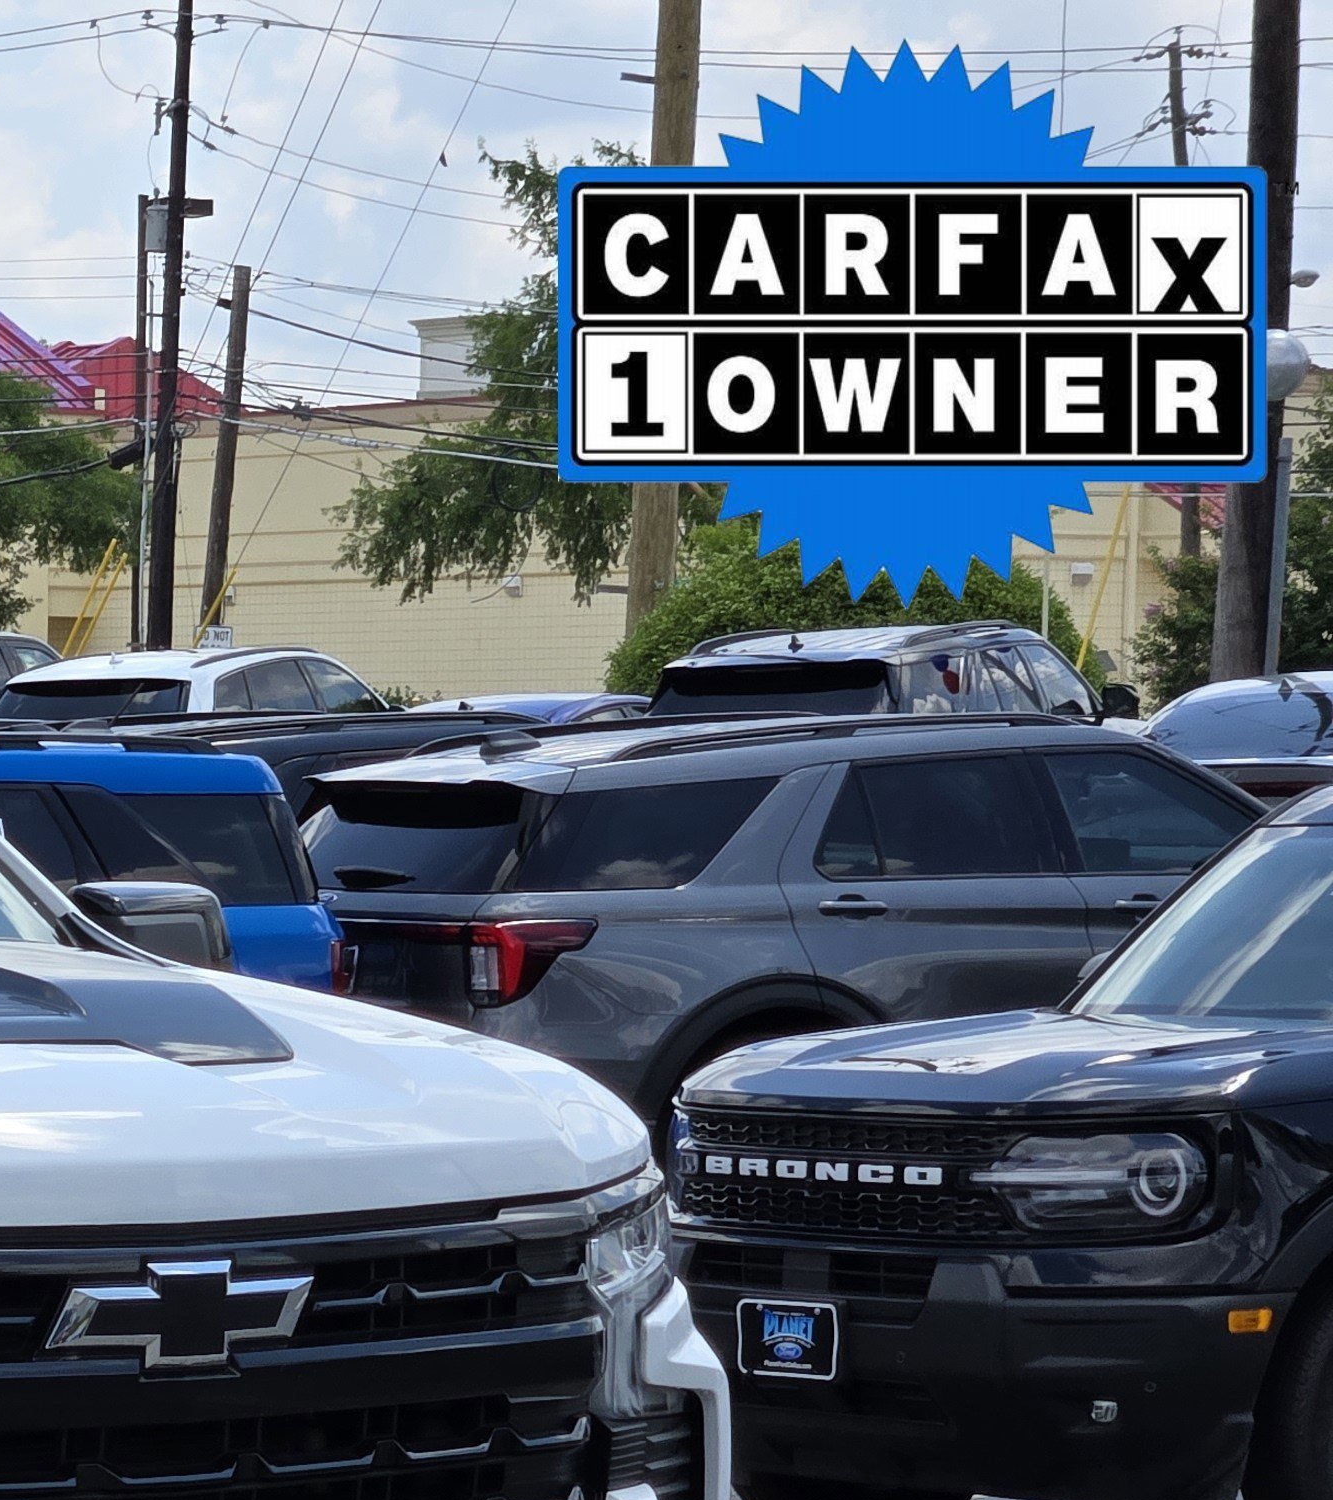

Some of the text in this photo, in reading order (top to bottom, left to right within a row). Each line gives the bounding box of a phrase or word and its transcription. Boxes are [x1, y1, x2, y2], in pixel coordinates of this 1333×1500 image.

[213, 630, 230, 641] NOT
[705, 1155, 943, 1186] BRONCO
[763, 1309, 815, 1341] PLANET
